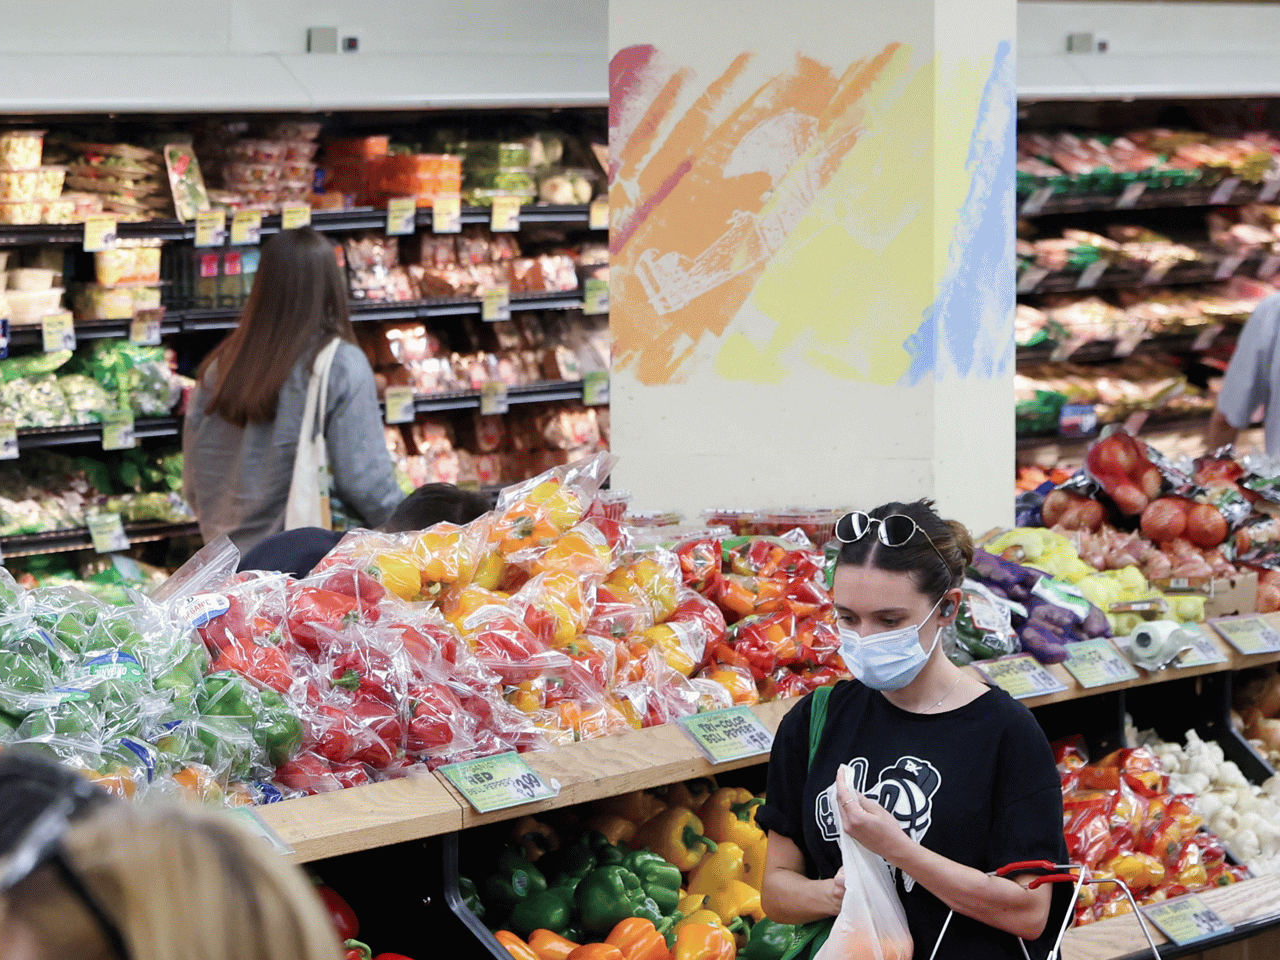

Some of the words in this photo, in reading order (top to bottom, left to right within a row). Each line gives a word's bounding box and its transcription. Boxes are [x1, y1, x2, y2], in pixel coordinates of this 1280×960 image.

[698, 716, 746, 733] TRI-COLOR
[702, 734, 726, 744] BELL
[465, 772, 494, 785] RED
